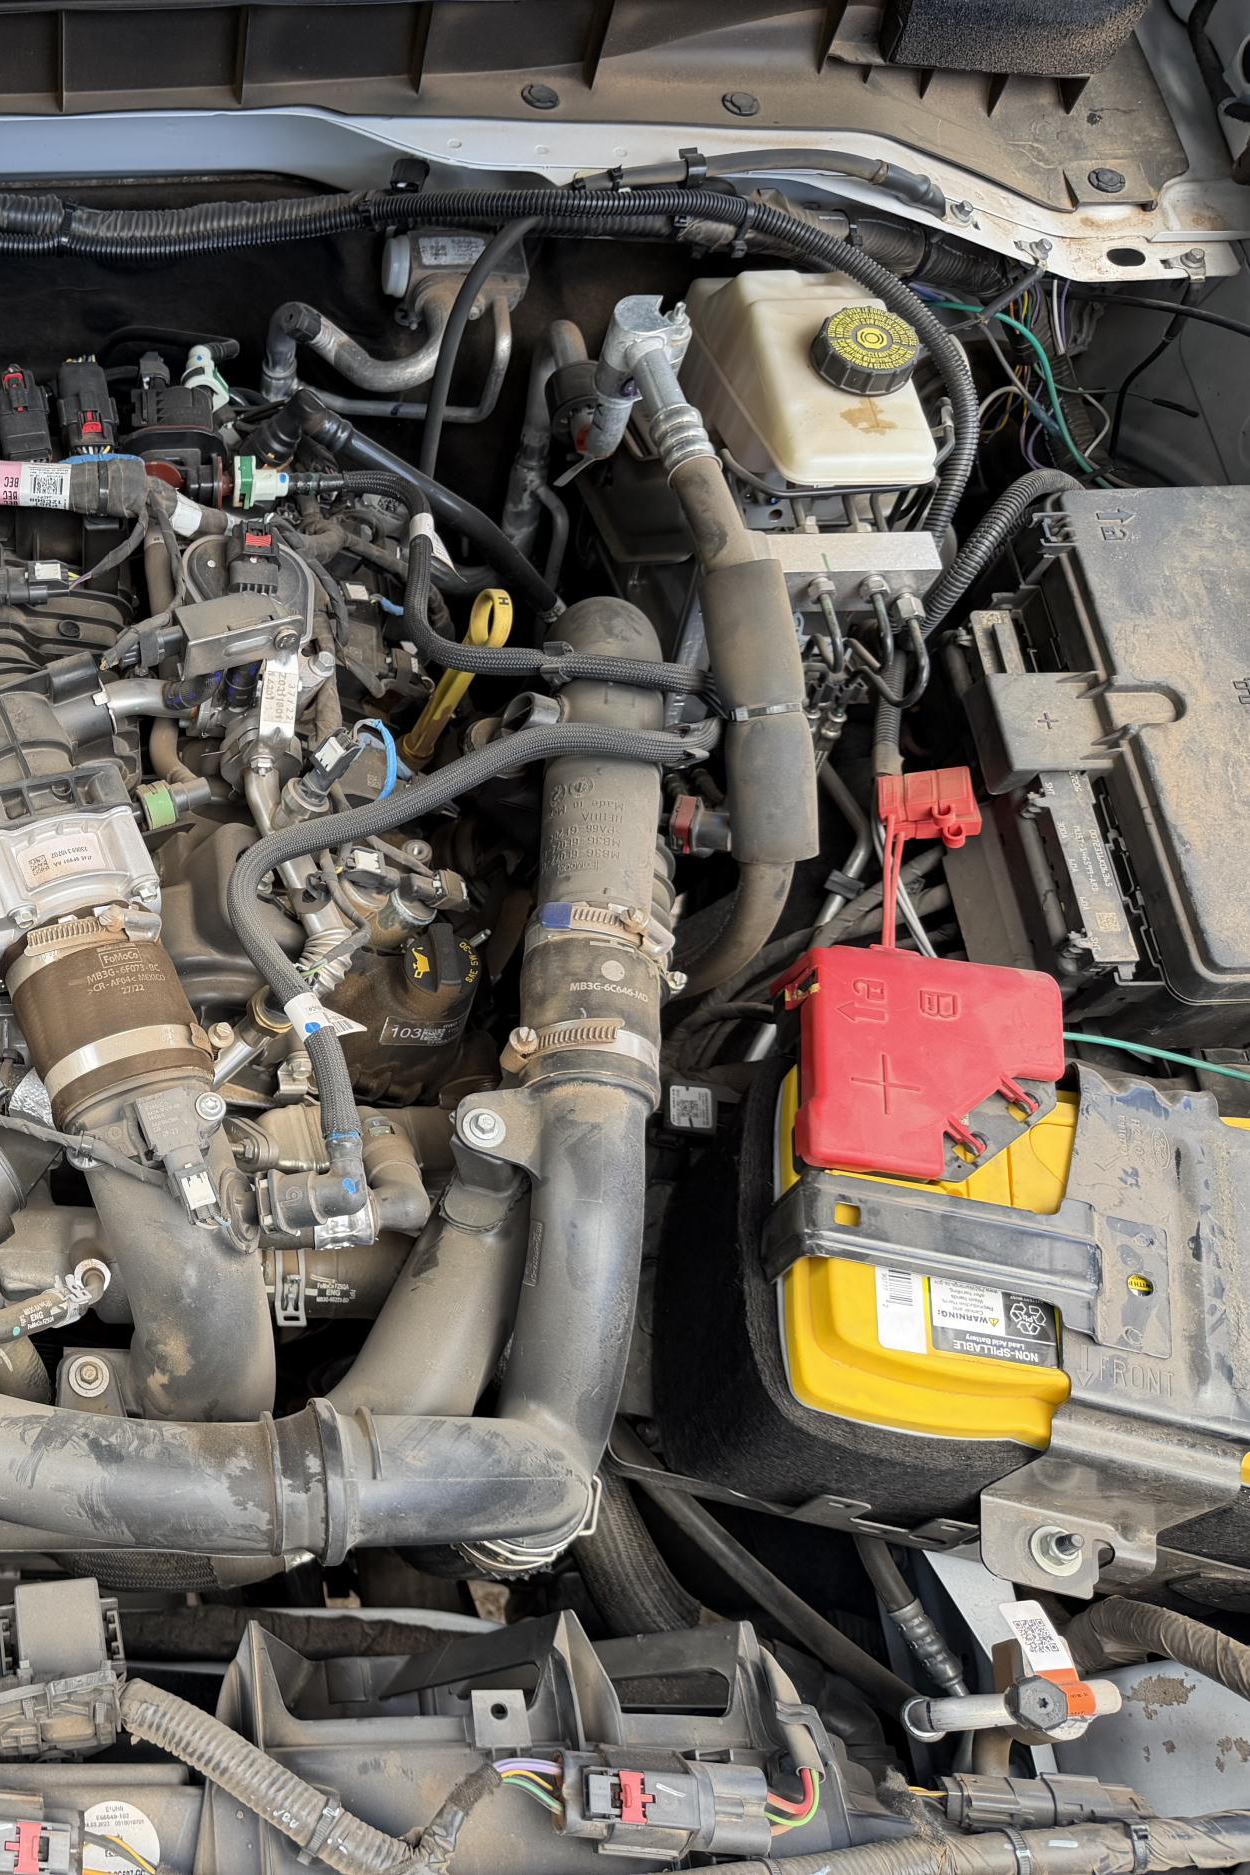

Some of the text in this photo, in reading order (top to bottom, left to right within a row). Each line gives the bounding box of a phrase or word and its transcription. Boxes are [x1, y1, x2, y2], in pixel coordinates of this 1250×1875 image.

[4, 476, 19, 488] BEC
[3, 490, 18, 500] BEC
[498, 597, 509, 606] H
[103, 951, 139, 964] FoMoCo
[459, 940, 479, 966] 5W-30
[465, 968, 479, 983] SAE
[30, 1311, 44, 1322] ENG
[937, 1309, 989, 1325] WARNING:
[965, 1333, 1025, 1350] Lead Acid Battery
[953, 1338, 1039, 1363] NON-SPILLABLE
[1100, 1356, 1175, 1398] FRONT
